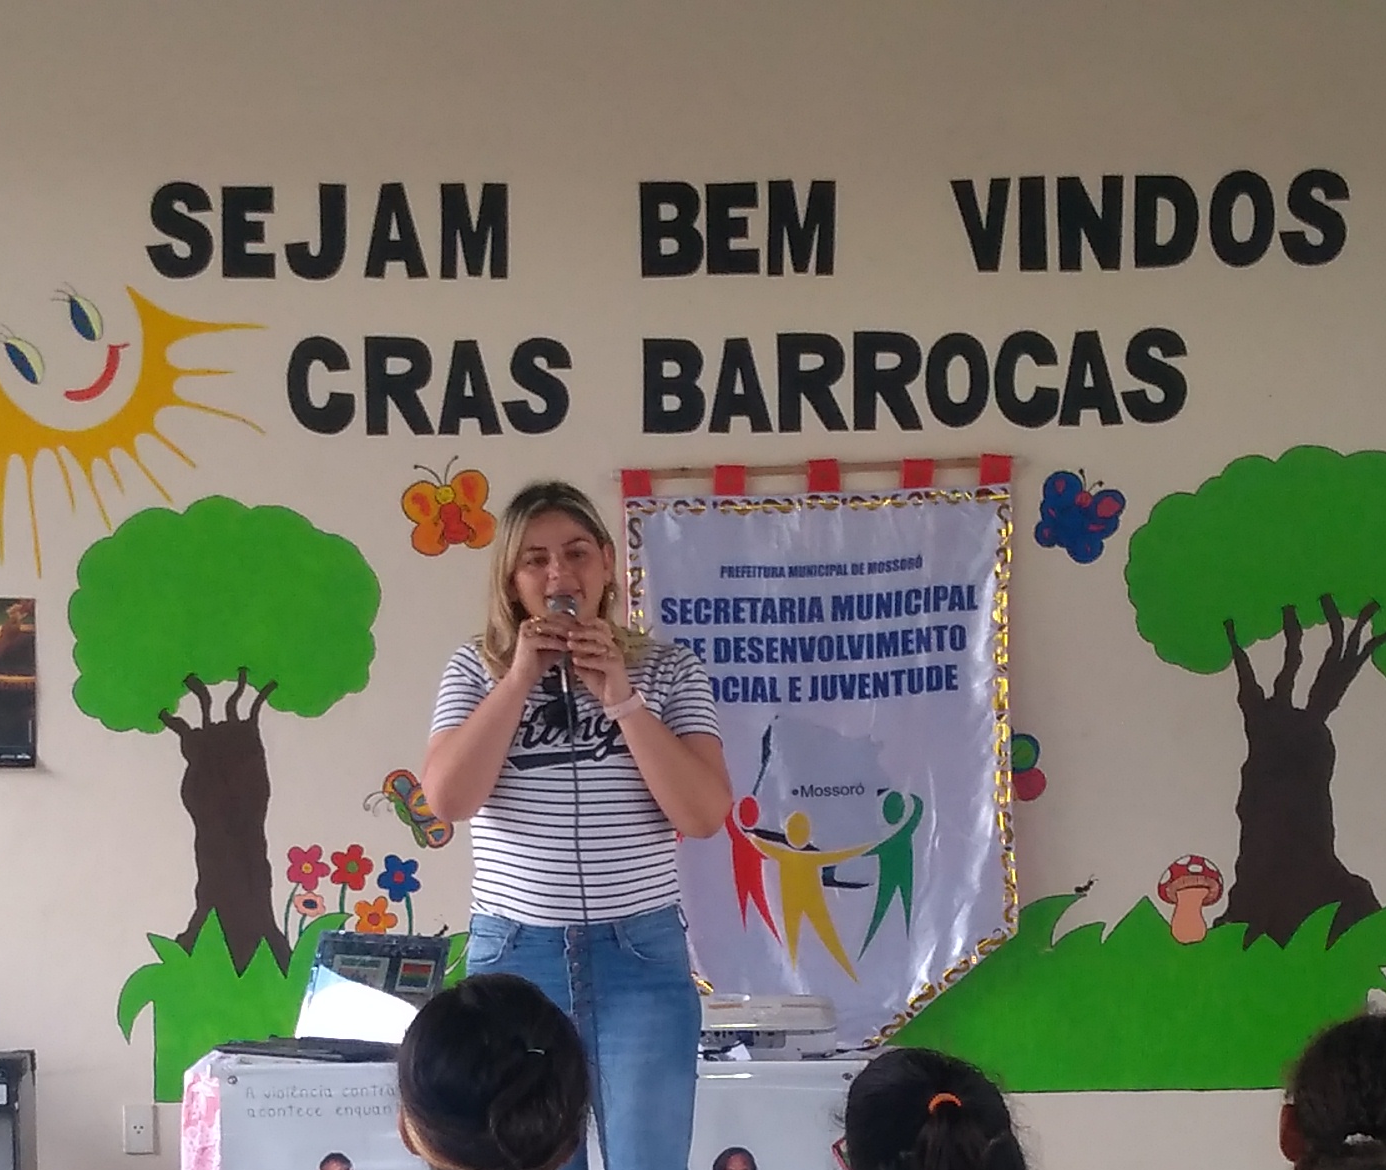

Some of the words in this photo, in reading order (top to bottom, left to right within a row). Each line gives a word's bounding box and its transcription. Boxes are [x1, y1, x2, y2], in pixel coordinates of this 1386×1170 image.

[145, 180, 509, 281] SEJAM
[638, 179, 836, 277] BEM
[949, 168, 1351, 273] VINDOS
[286, 336, 572, 436] CRAS
[642, 327, 1189, 435] BARROCAS
[720, 564, 786, 579] PREFEITURA
[788, 563, 849, 578] MUNICIPAL
[851, 560, 865, 576] DE
[867, 554, 924, 576] MOSSORÓ
[661, 596, 825, 626] SECRETARIA
[831, 584, 979, 622] MUNICIPAL
[713, 624, 968, 665] DESENVOLVIMENTO
[788, 675, 802, 702] E
[808, 664, 959, 702] JUVENTUDE
[800, 782, 865, 798] Mossoró
[264, 1085, 333, 1099] violência
[342, 1084, 396, 1098] contra
[247, 1106, 323, 1118] acontece
